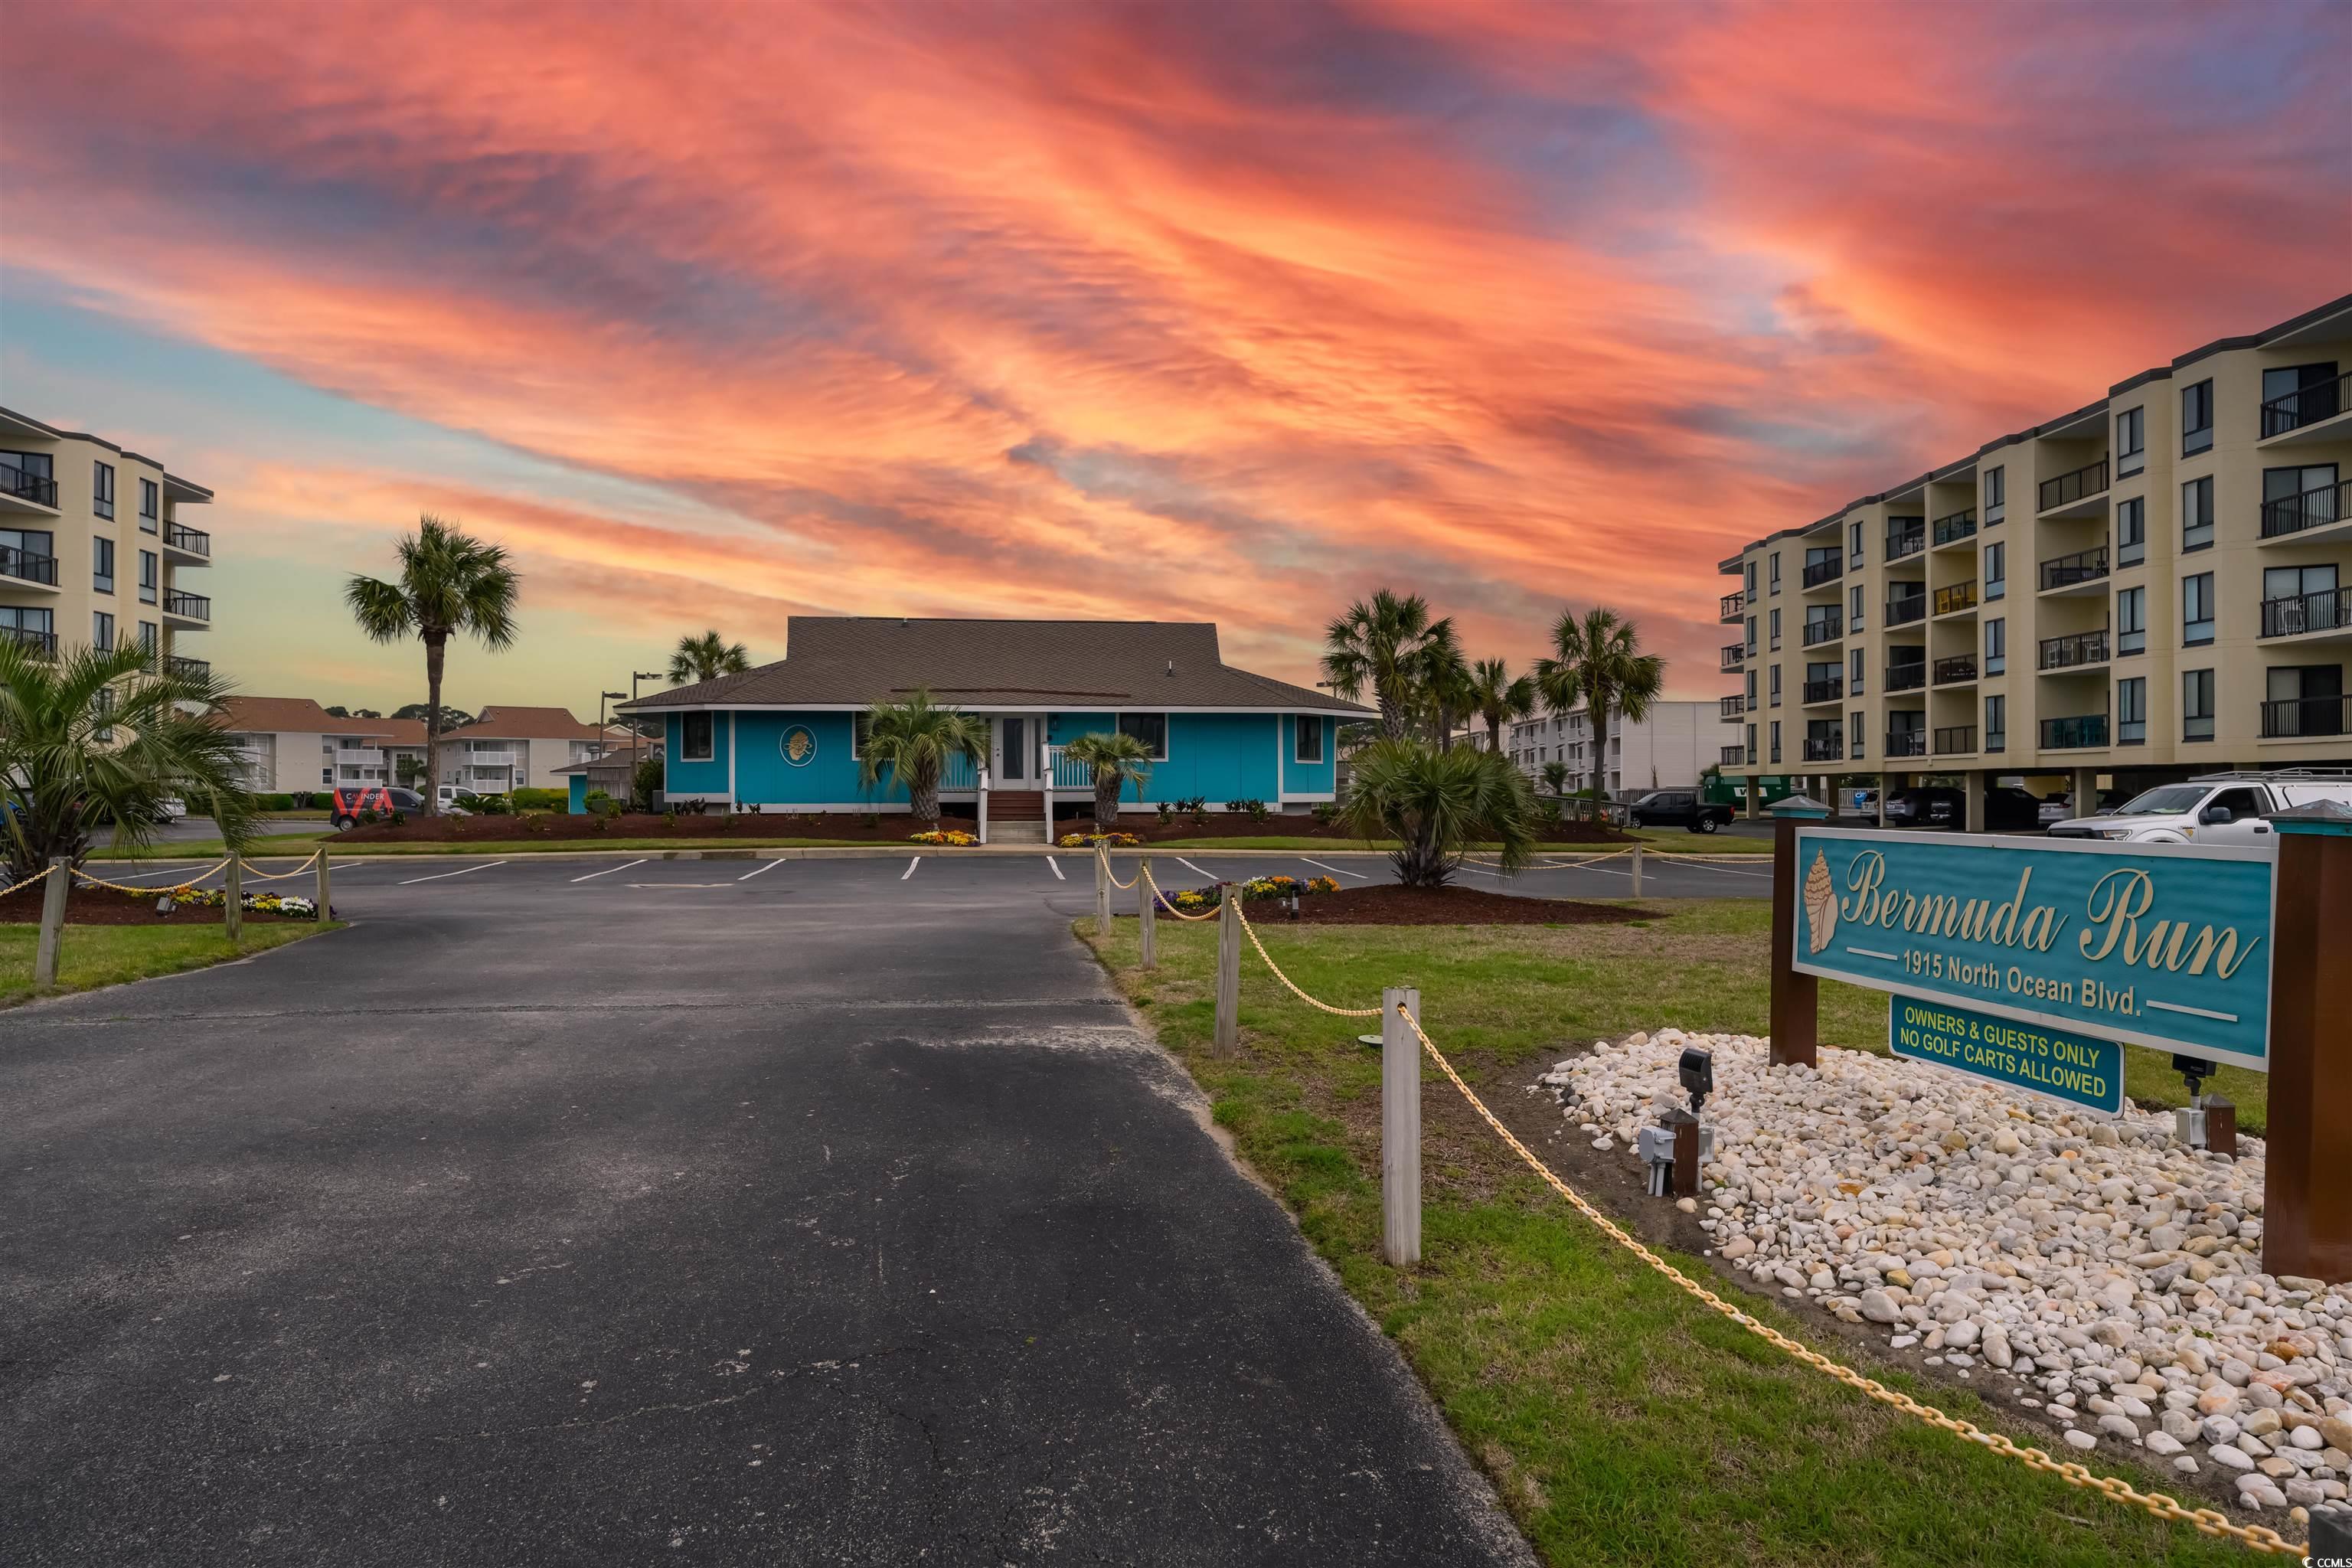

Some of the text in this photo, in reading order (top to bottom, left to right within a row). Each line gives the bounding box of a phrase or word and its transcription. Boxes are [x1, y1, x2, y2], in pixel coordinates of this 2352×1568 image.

[1841, 850, 2261, 980] Bermuda Run
[1904, 949, 2141, 1017] 1915 North Ocean Blvd.
[1900, 1027, 2106, 1097] NO GOLF CARTS ALLOWED
[1905, 1006, 2100, 1069] OWNERS & GUESTS ONLY
